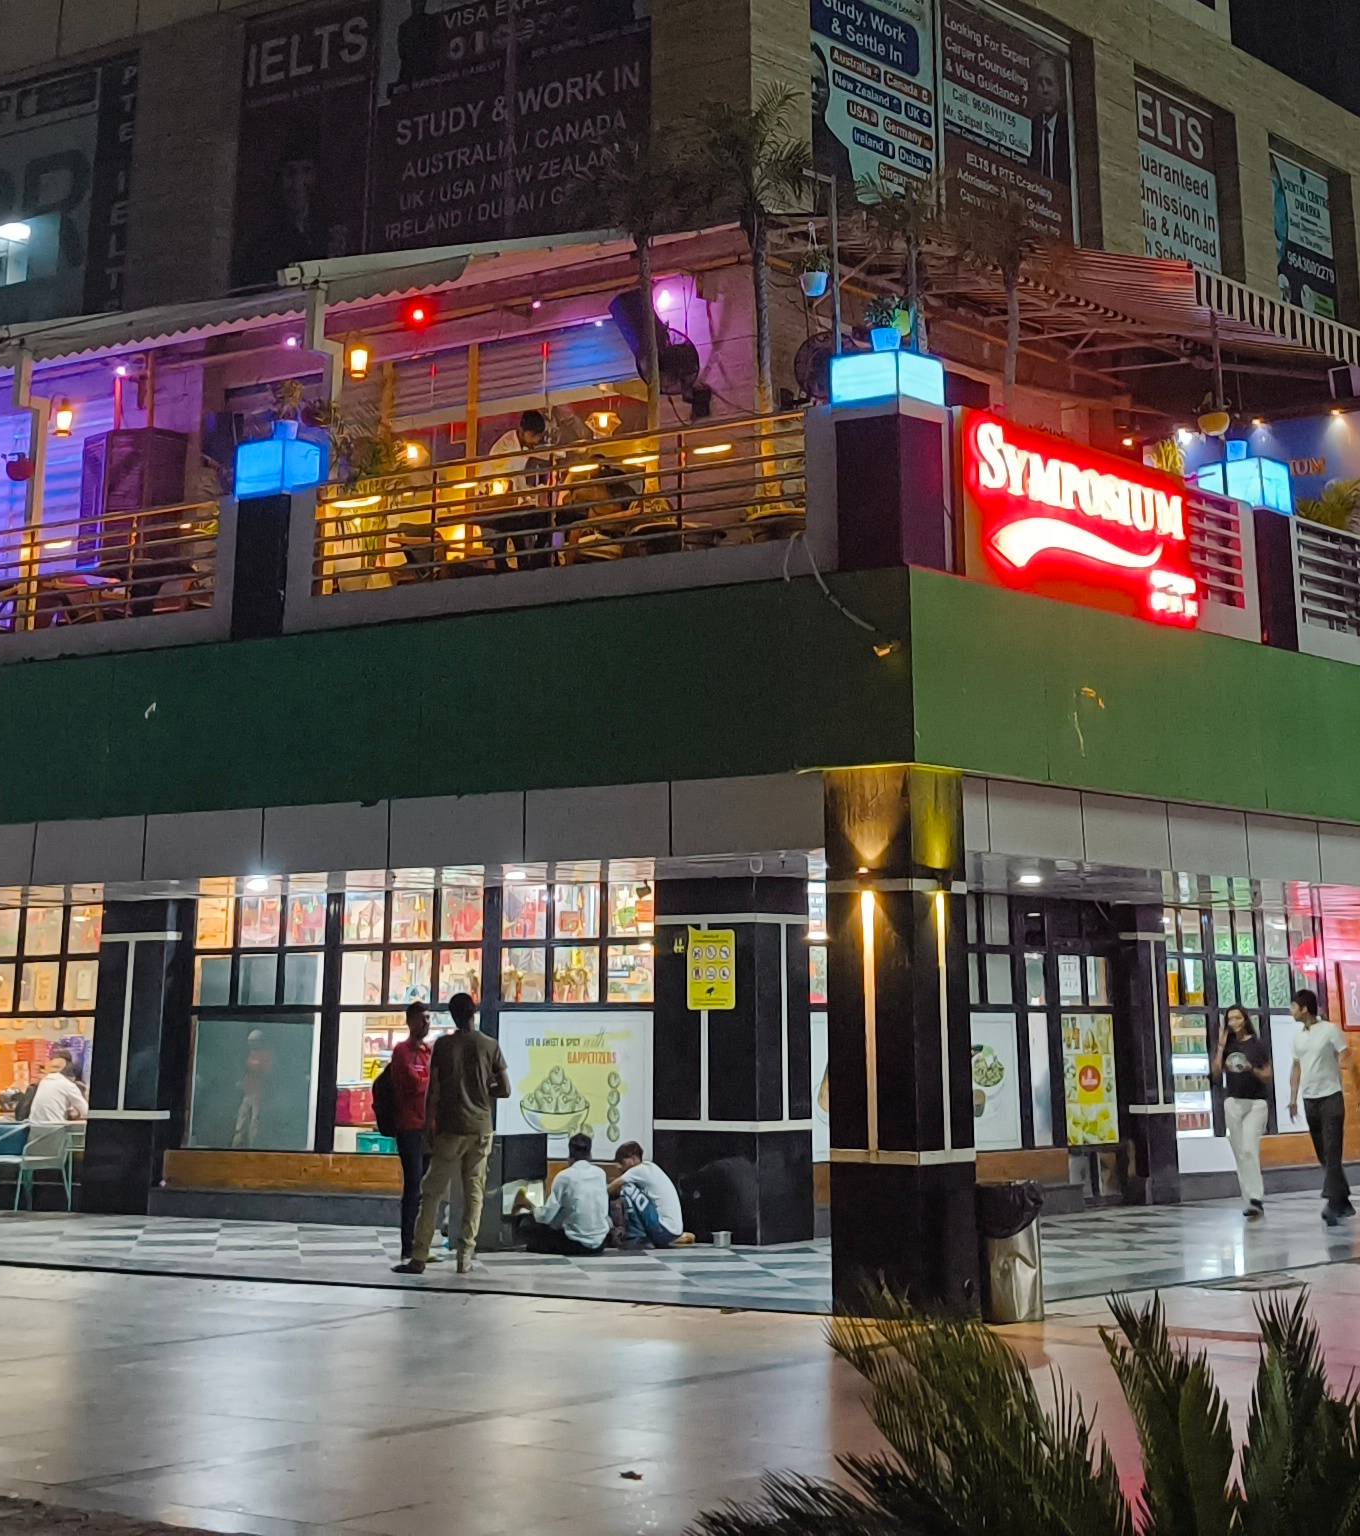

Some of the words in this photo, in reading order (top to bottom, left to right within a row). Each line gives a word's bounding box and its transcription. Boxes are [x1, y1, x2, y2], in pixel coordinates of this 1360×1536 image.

[443, 5, 489, 30] VISA
[870, 11, 909, 44] Work
[943, 12, 982, 48] Looking
[983, 34, 1000, 52] For
[247, 16, 369, 89] IELTS
[831, 17, 843, 37] &
[845, 23, 887, 57] Settle
[889, 43, 904, 64] In
[944, 35, 977, 63] Career
[832, 50, 872, 76] Australia
[834, 73, 855, 92] New
[855, 80, 890, 108] Zealand
[885, 72, 919, 97] Canada
[955, 61, 976, 84] Visa
[977, 74, 1021, 105] Guidance
[119, 64, 137, 144] PTE
[395, 99, 486, 146] STUDY
[490, 95, 506, 123] &
[516, 72, 607, 116] WORK
[613, 60, 641, 94] IN
[848, 102, 869, 121] USA
[907, 104, 921, 121] UK
[853, 130, 884, 152] Ireland
[883, 118, 924, 147] Germany
[1136, 89, 1205, 161] ELTS
[401, 133, 518, 181] AUSTRALIA
[535, 109, 628, 150] CANADA
[899, 148, 925, 168] Dubai
[966, 152, 990, 175] IELTS
[998, 166, 1016, 186] PTE
[399, 188, 425, 212] UK
[439, 176, 476, 204] USA
[490, 163, 534, 191] NEW
[384, 208, 462, 242] IRELAND
[1161, 216, 1171, 238] &
[1173, 221, 1217, 260] Abroad
[976, 421, 1186, 541] SYMPOSIUM
